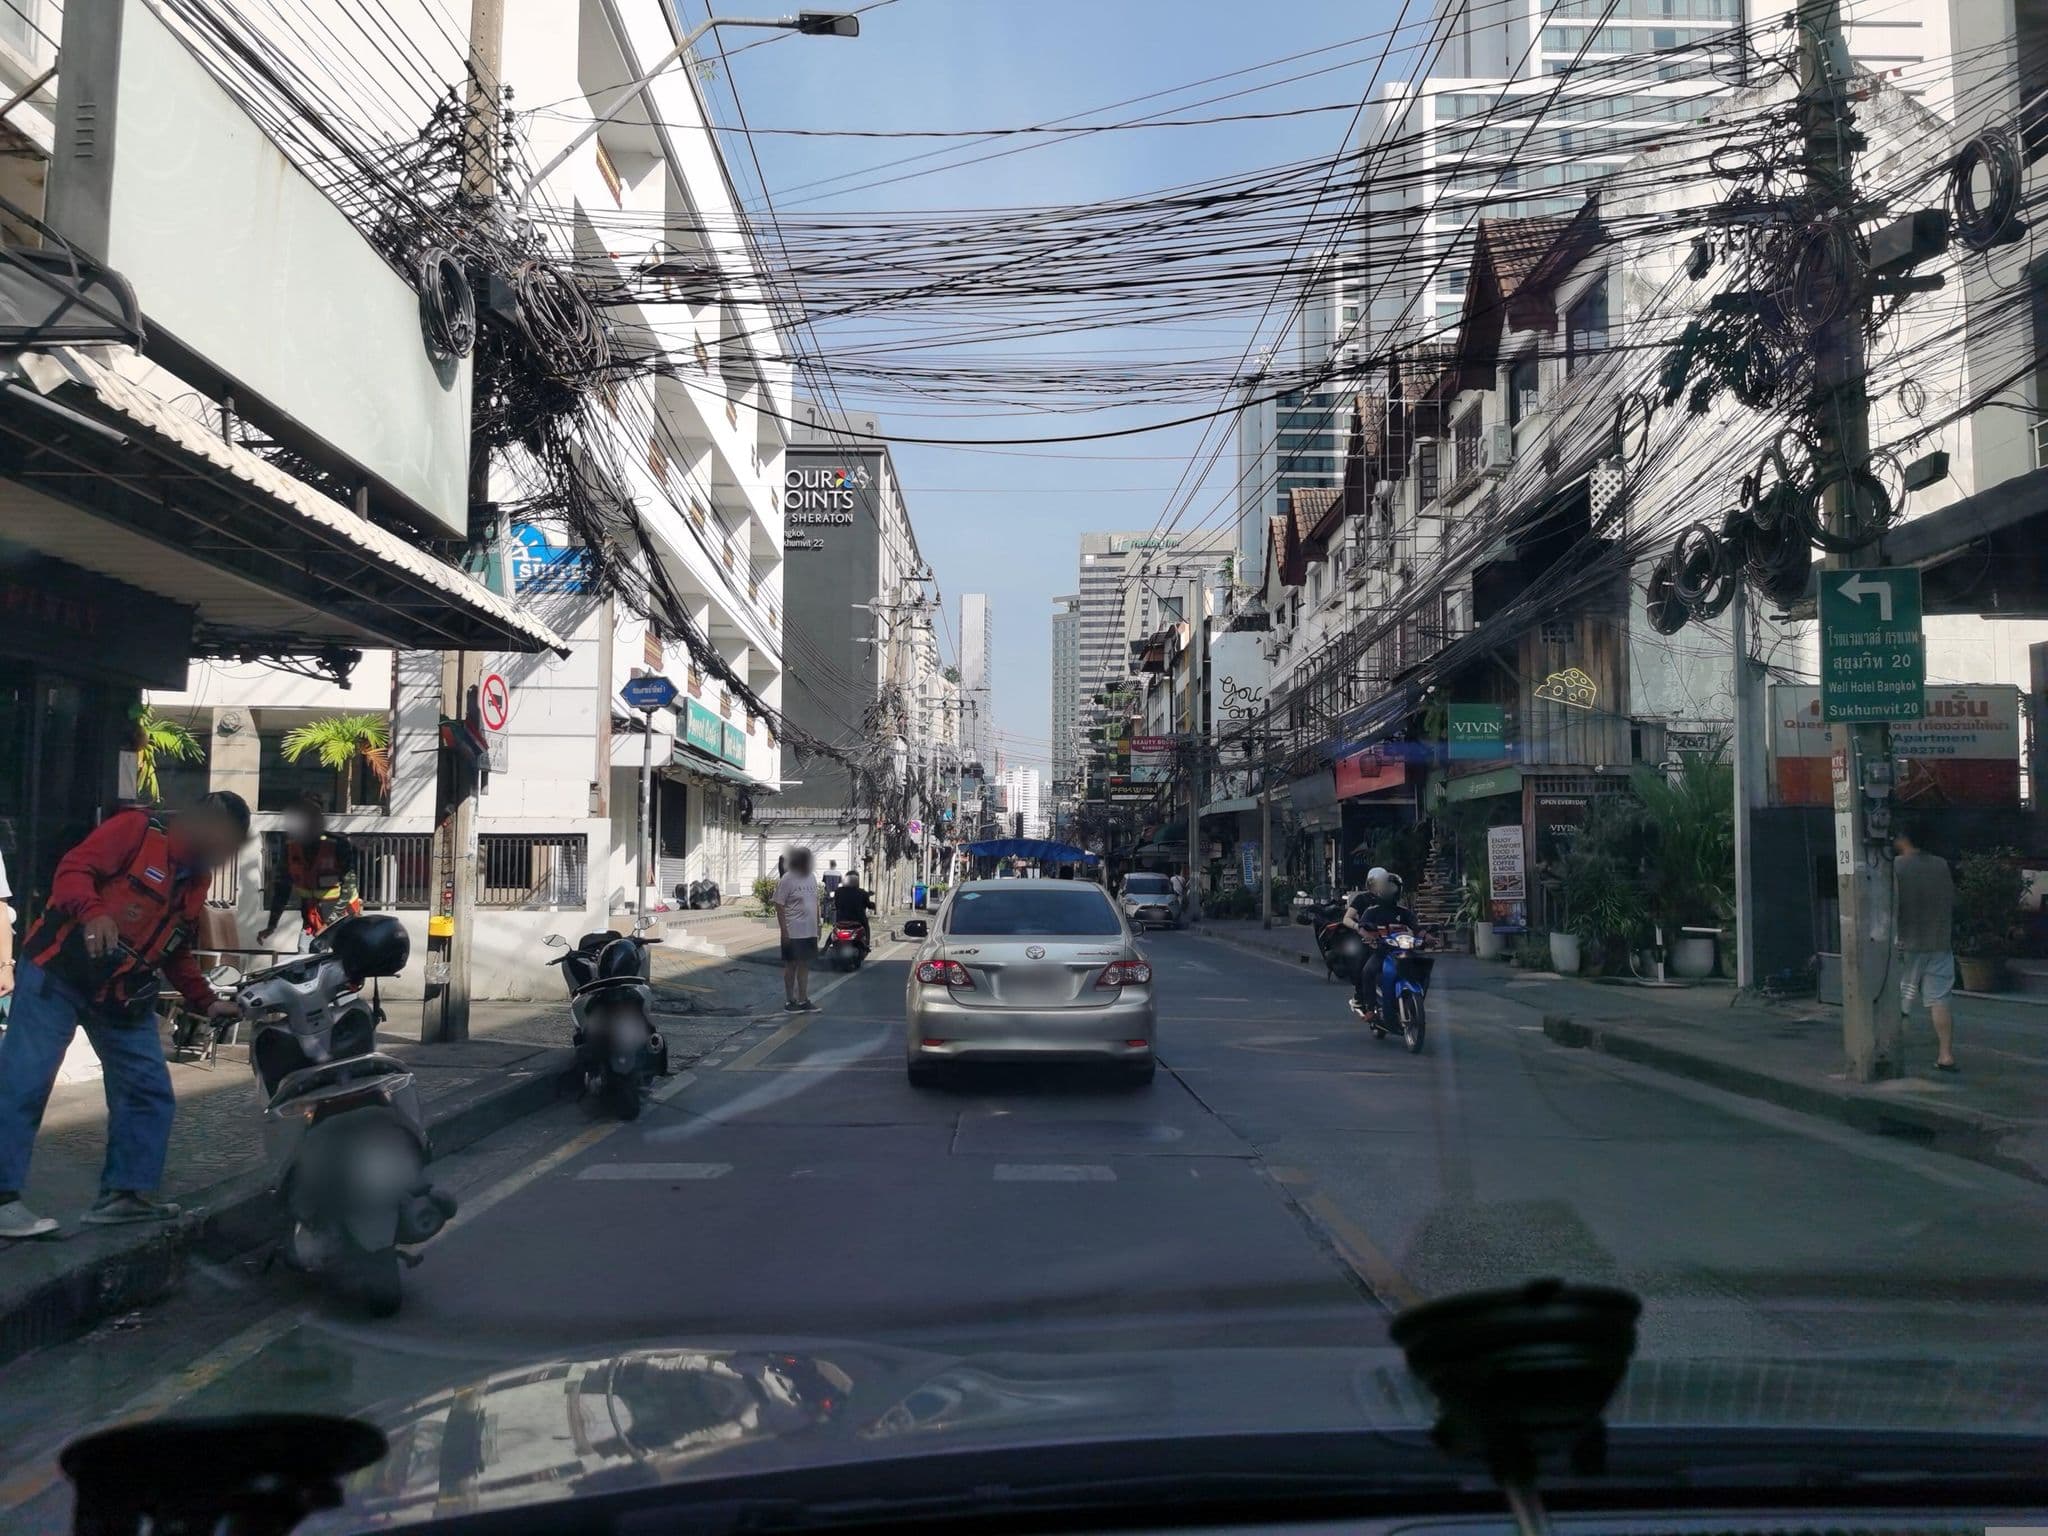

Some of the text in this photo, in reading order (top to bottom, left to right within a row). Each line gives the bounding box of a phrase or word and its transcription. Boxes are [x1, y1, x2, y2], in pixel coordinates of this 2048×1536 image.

[785, 470, 834, 488] OUR
[785, 490, 854, 509] OINTS
[792, 513, 854, 523] SHERATON
[813, 539, 824, 547] 22
[1832, 650, 1911, 675] สุขุมวิท 20
[1828, 680, 1917, 694] Well Hotel Bangkok
[1829, 703, 1902, 717] Sukhumvit
[1904, 702, 1918, 715] 20
[1893, 733, 1977, 744] Apartment
